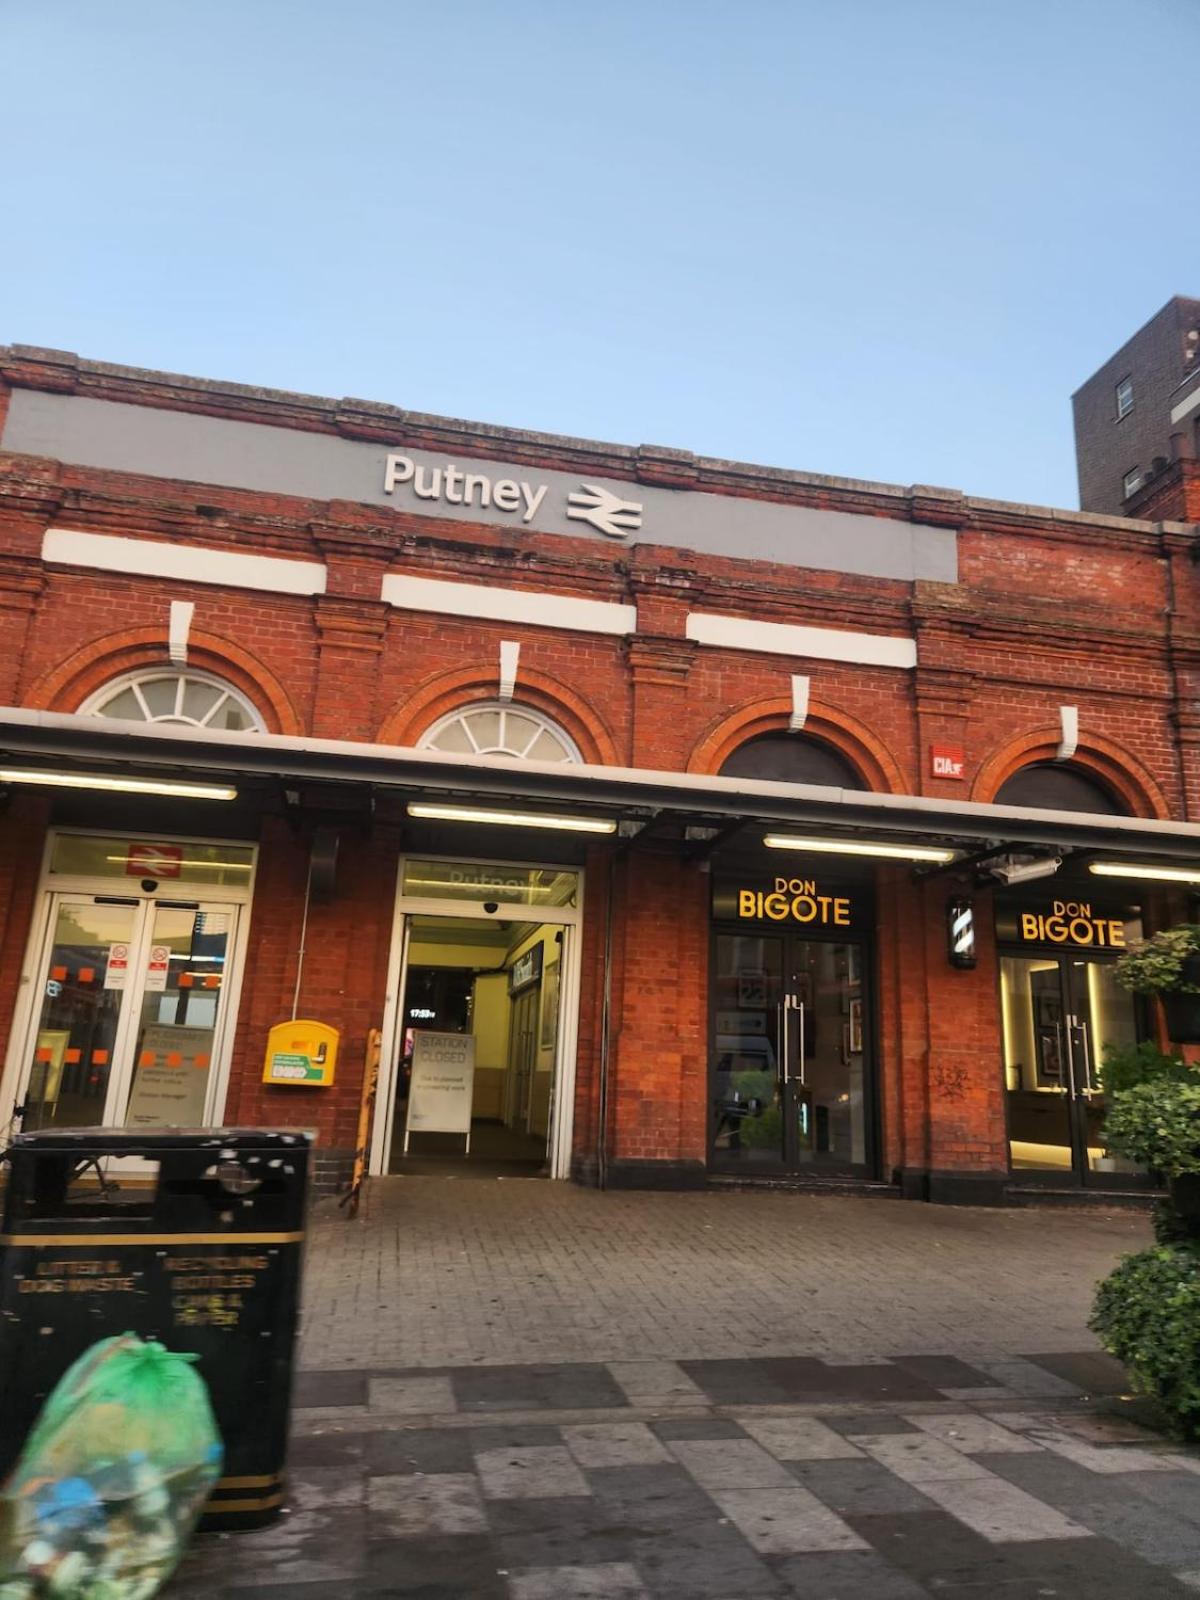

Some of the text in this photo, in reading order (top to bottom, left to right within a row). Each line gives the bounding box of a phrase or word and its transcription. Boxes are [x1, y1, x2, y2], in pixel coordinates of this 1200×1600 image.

[384, 454, 548, 523] Putney
[775, 877, 816, 896] DON
[738, 889, 850, 925] BIGOTE
[1053, 900, 1091, 919] DON
[1021, 913, 1126, 947] BIGOTE
[420, 1036, 468, 1049] STATION
[420, 1050, 466, 1064] CLOSED
[18, 1277, 136, 1293] DOG WASTE
[171, 1275, 256, 1289] BOTTLES
